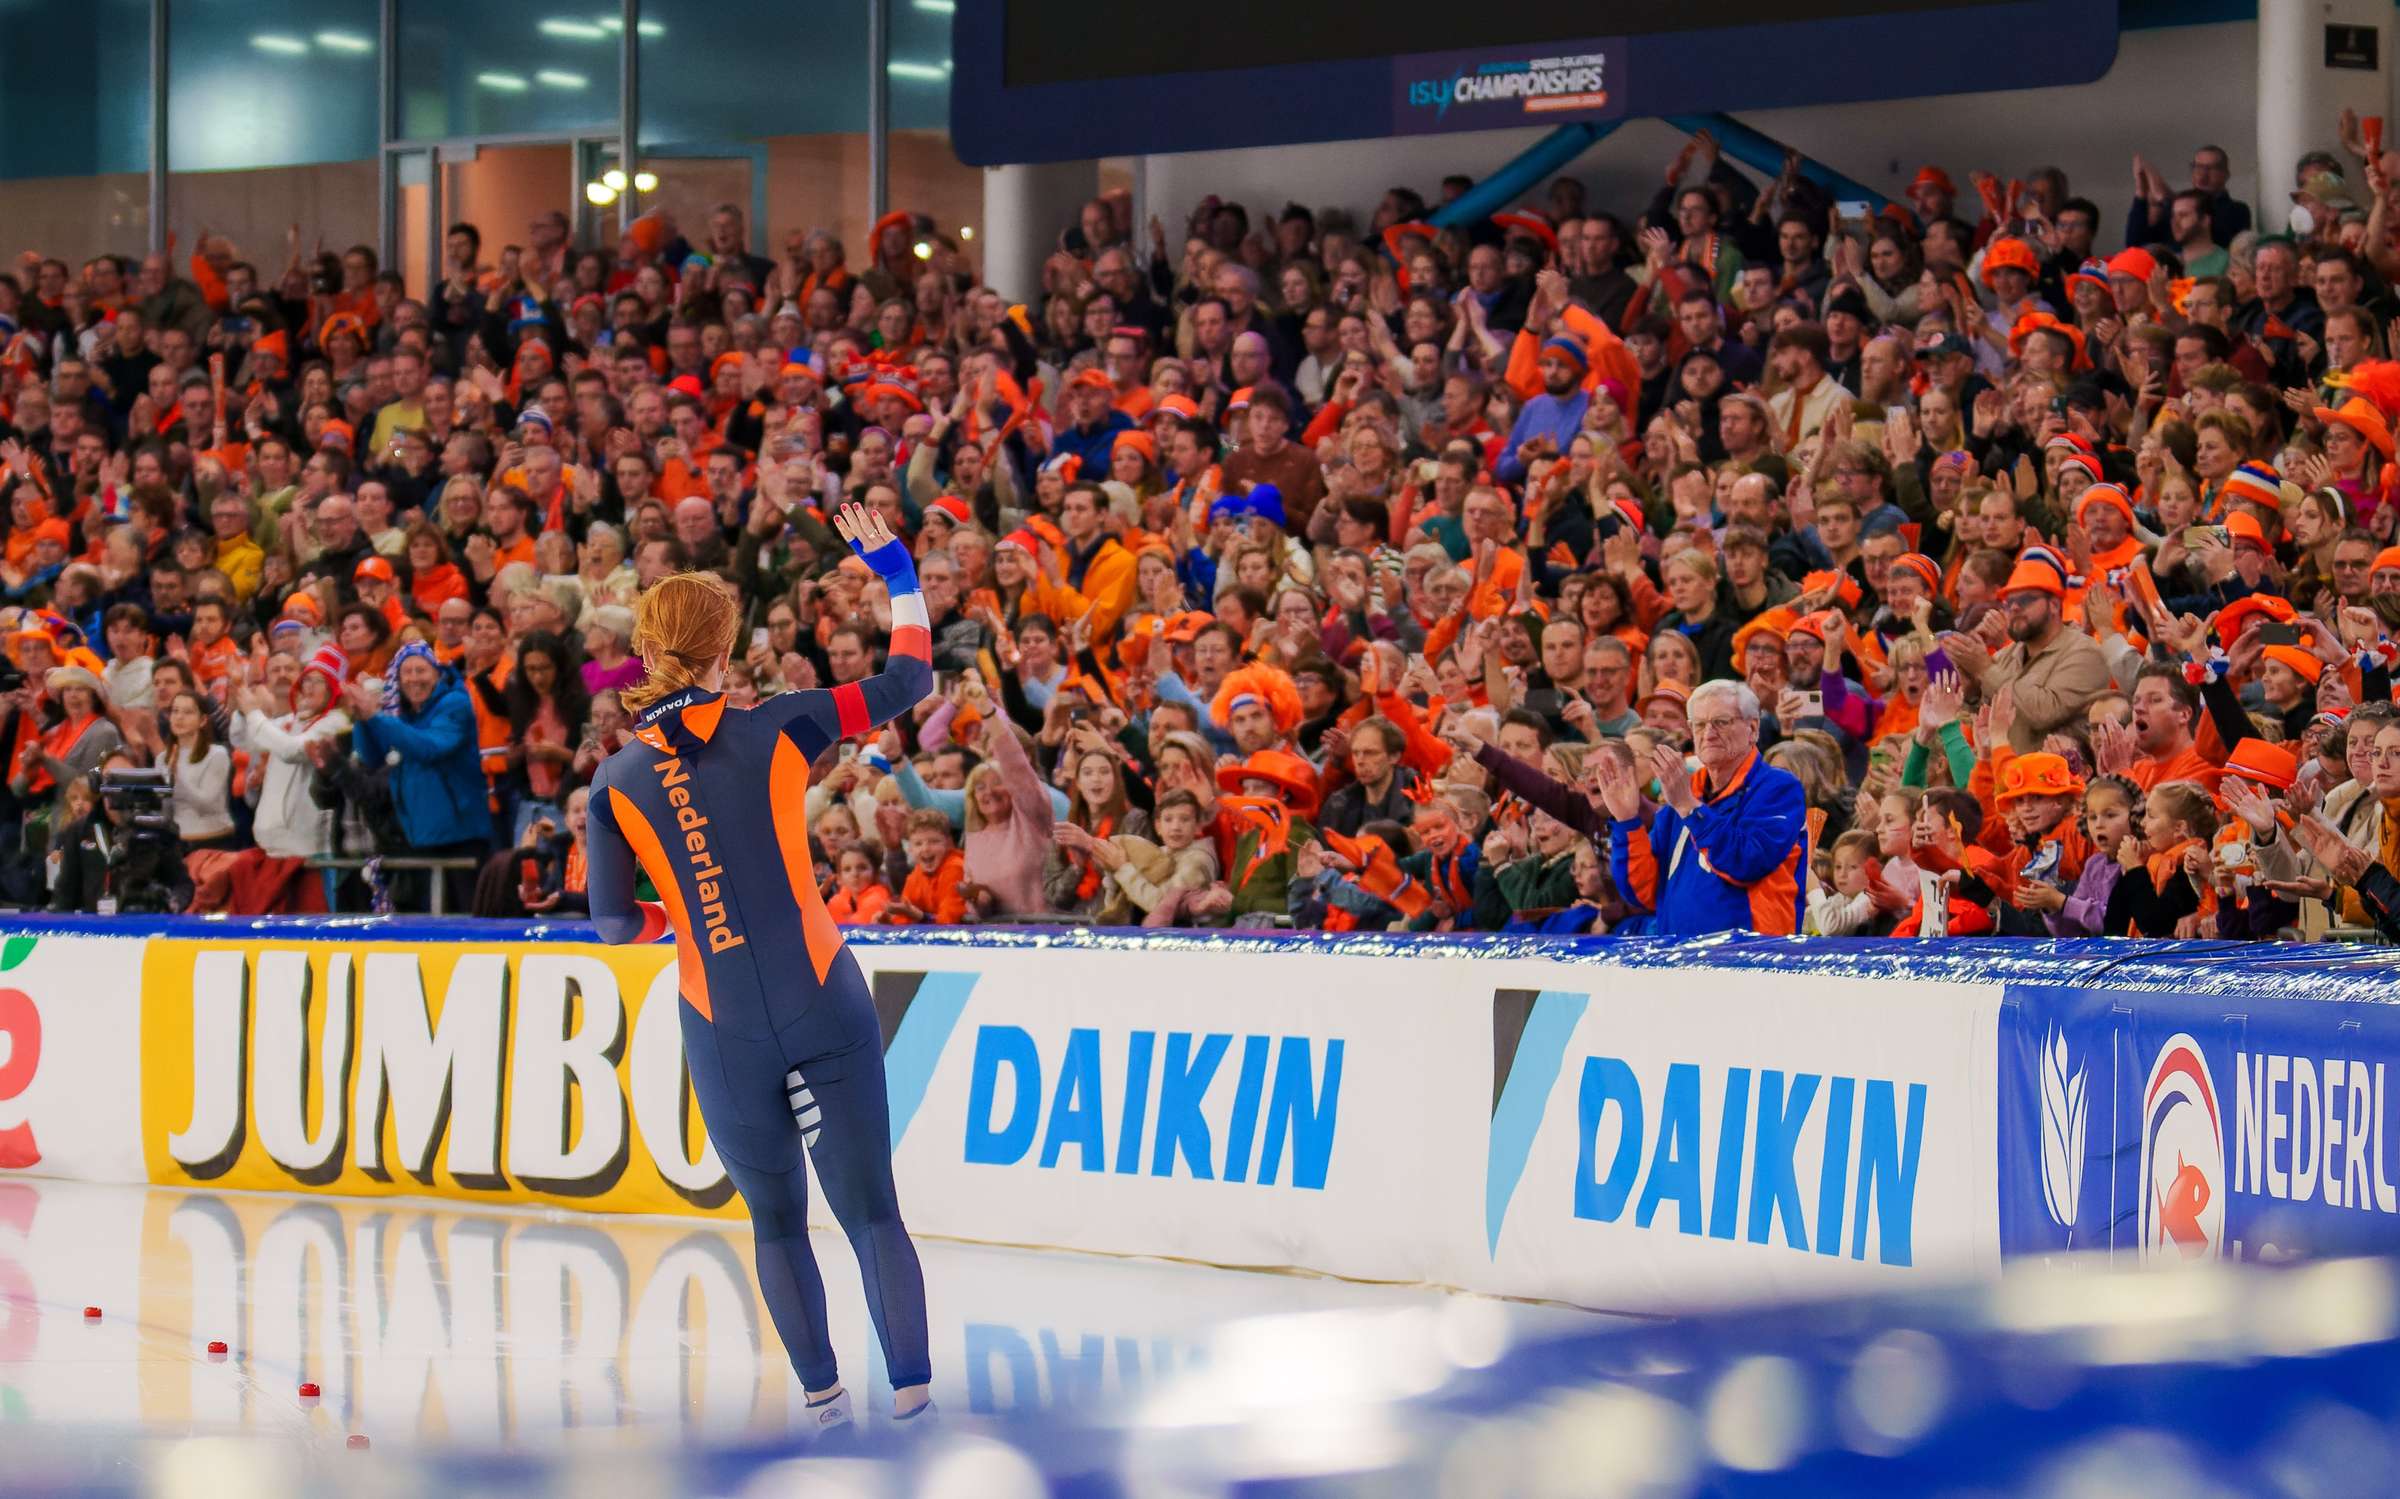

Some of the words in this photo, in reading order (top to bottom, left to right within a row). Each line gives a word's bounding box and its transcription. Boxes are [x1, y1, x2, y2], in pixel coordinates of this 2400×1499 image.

[1453, 67, 1603, 103] CHAMPIONSHIPS
[645, 698, 684, 722] DAIKIN
[653, 757, 744, 954] Nederland
[964, 1023, 1346, 1191] DAIKIN
[1573, 1055, 1928, 1268] DAIKIN
[2234, 1051, 2400, 1215] NEDERL
